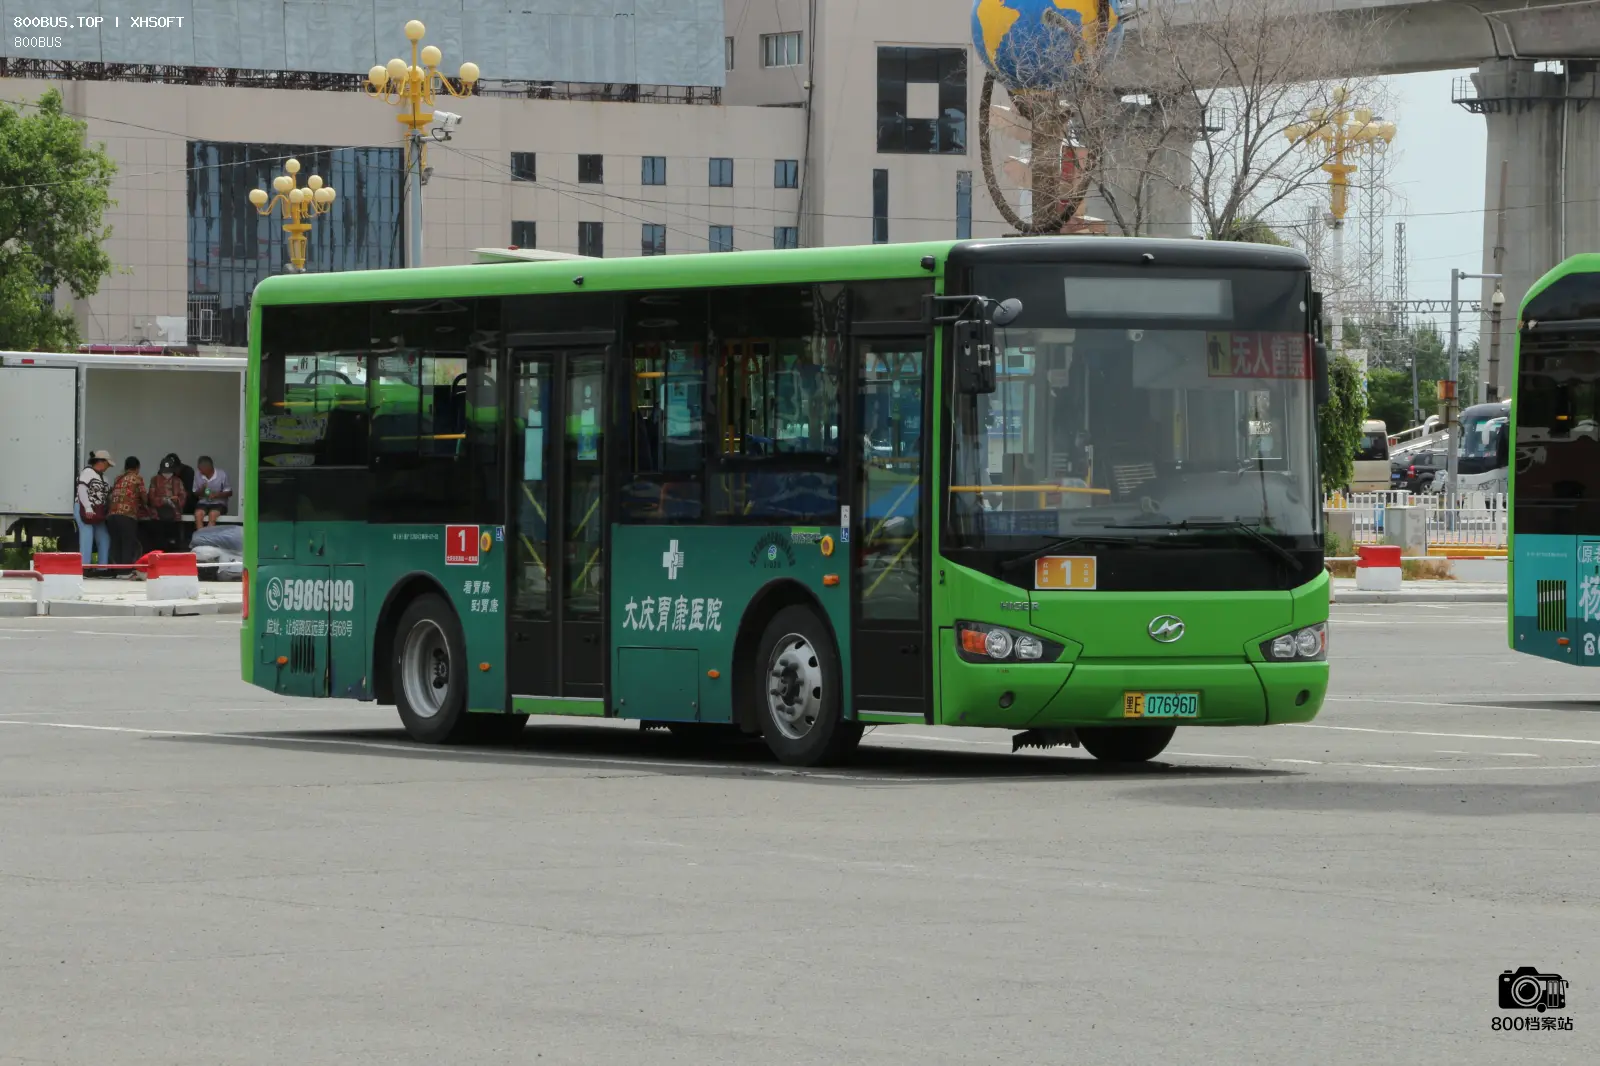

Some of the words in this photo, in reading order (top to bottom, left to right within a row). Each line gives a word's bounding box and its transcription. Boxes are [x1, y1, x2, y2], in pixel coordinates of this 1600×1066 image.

[458, 529, 467, 552] 1
[1060, 560, 1072, 586] 1
[283, 579, 354, 612] 5986999
[622, 594, 723, 633] 大庆胃康医院
